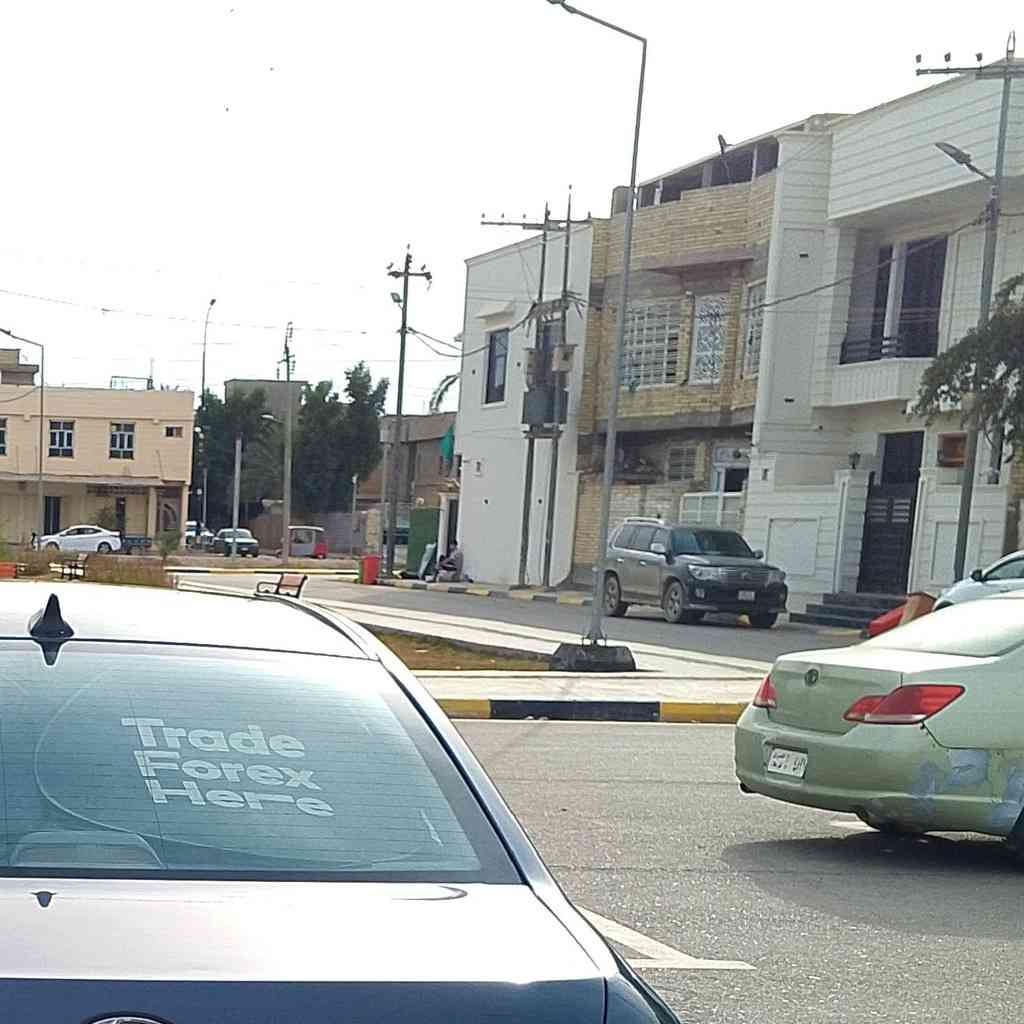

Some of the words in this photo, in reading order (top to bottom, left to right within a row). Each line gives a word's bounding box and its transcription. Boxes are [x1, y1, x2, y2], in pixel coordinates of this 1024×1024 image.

[121, 717, 306, 758] Trade
[133, 750, 323, 791] Forex
[144, 778, 336, 817] Here
